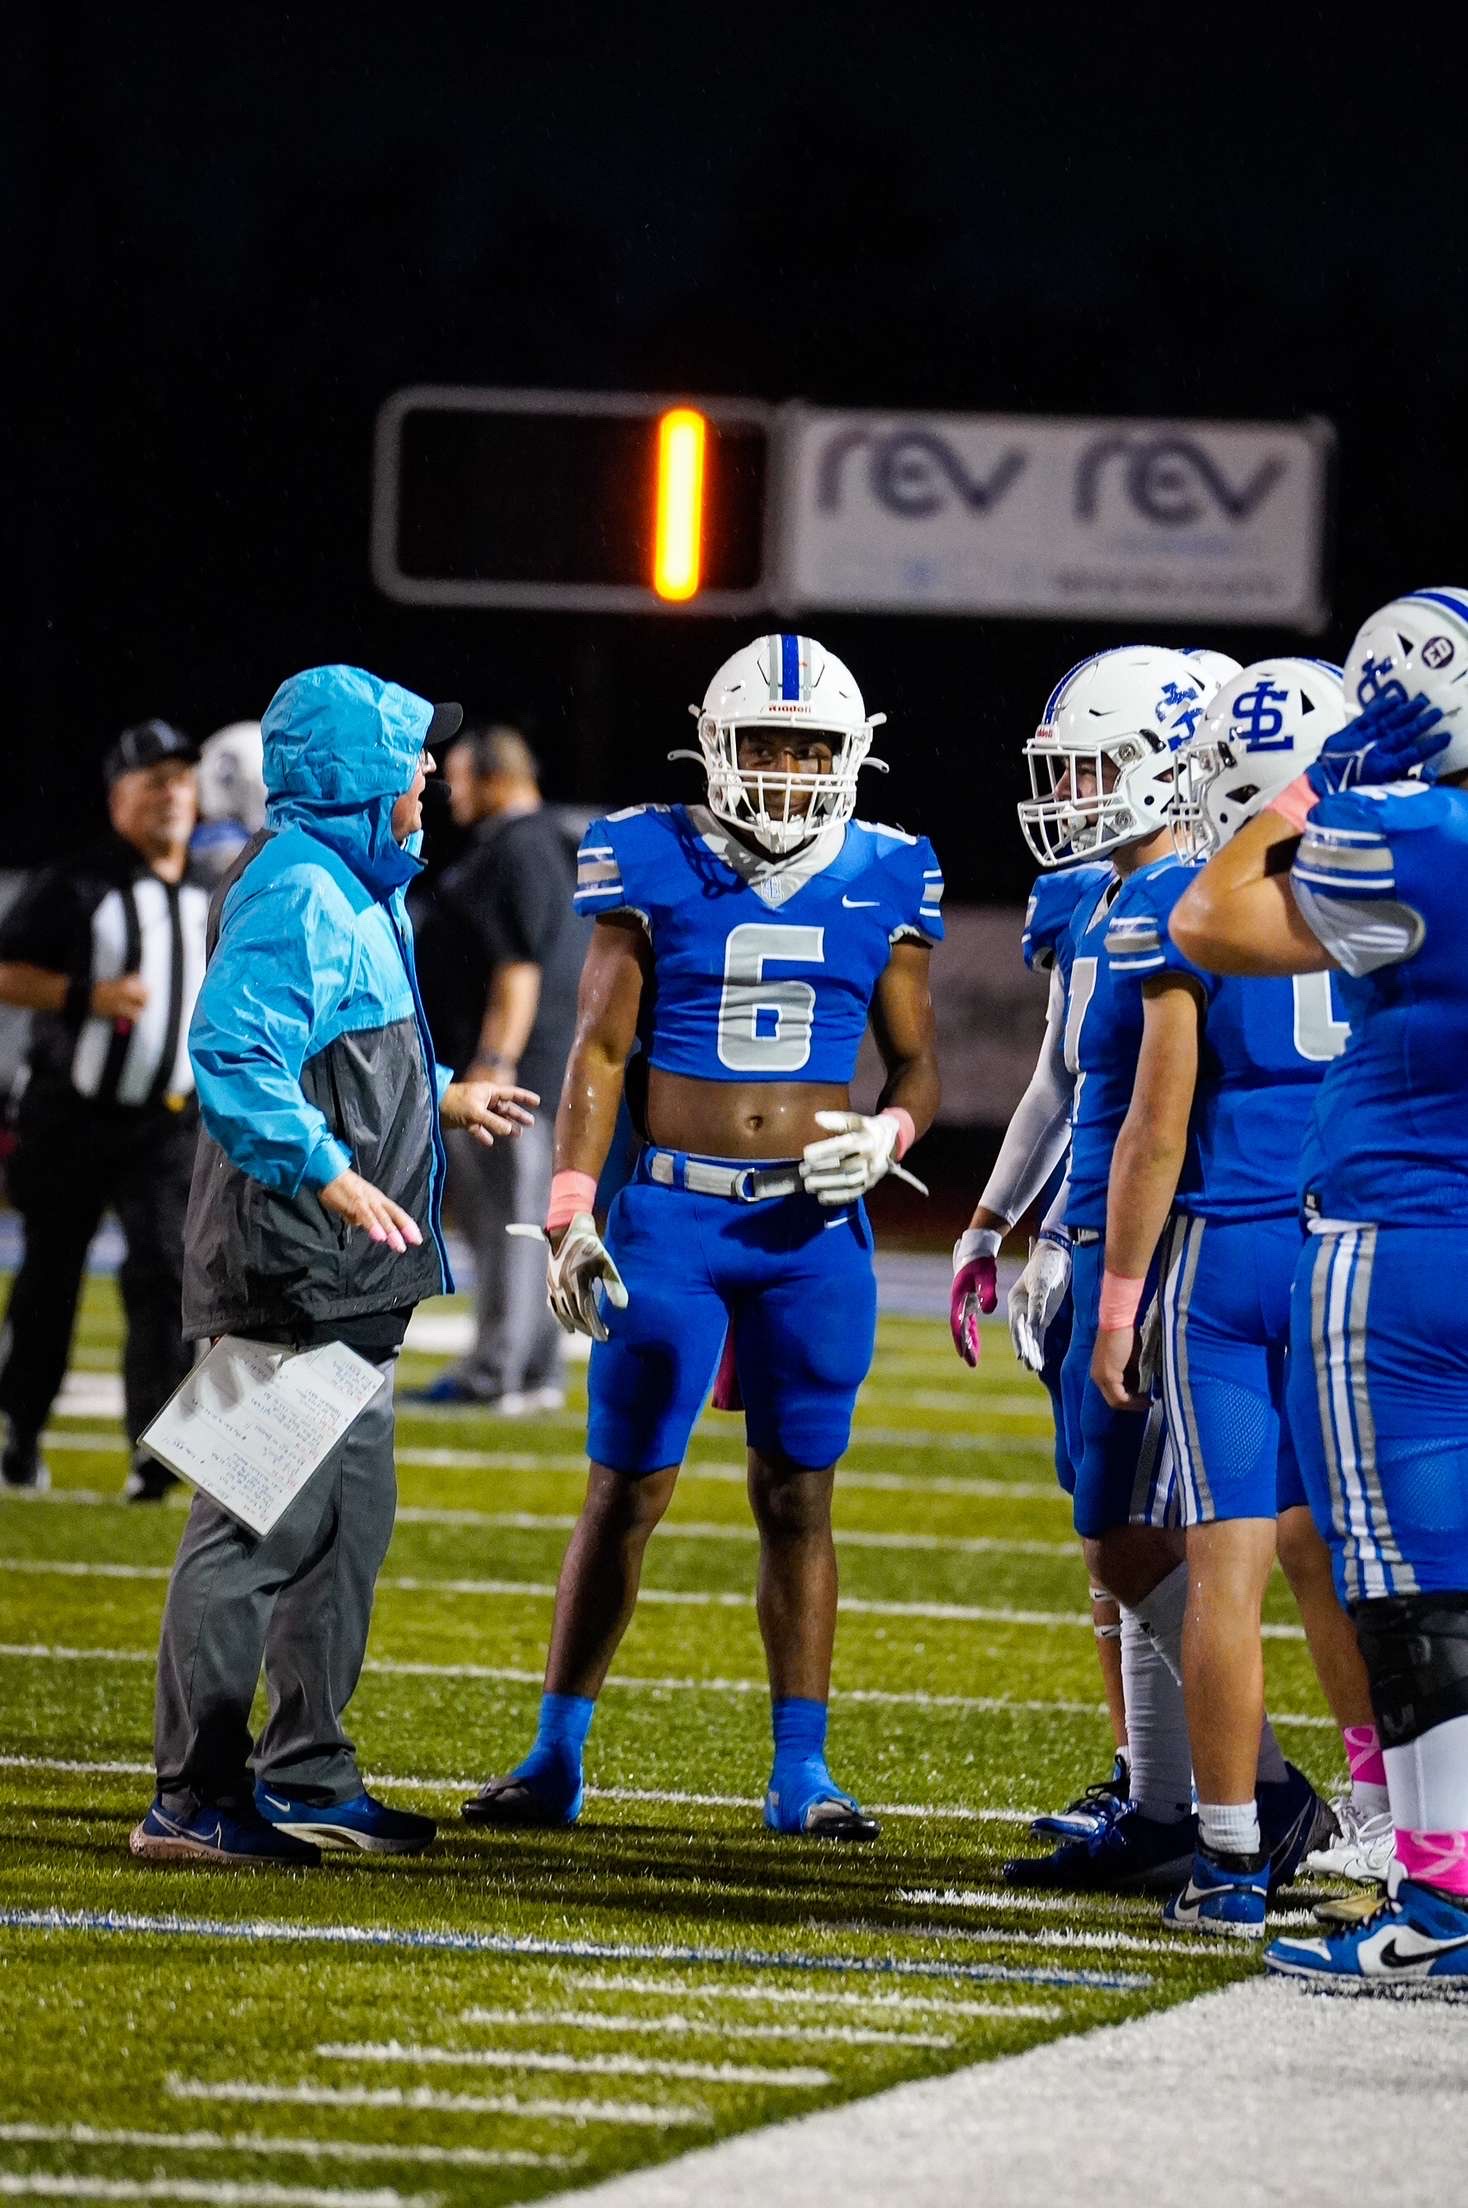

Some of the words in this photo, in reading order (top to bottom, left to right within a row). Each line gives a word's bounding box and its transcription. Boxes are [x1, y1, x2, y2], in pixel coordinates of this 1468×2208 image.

[816, 426, 1028, 519] rev
[1072, 431, 1290, 527] rev
[716, 922, 825, 1073] 6
